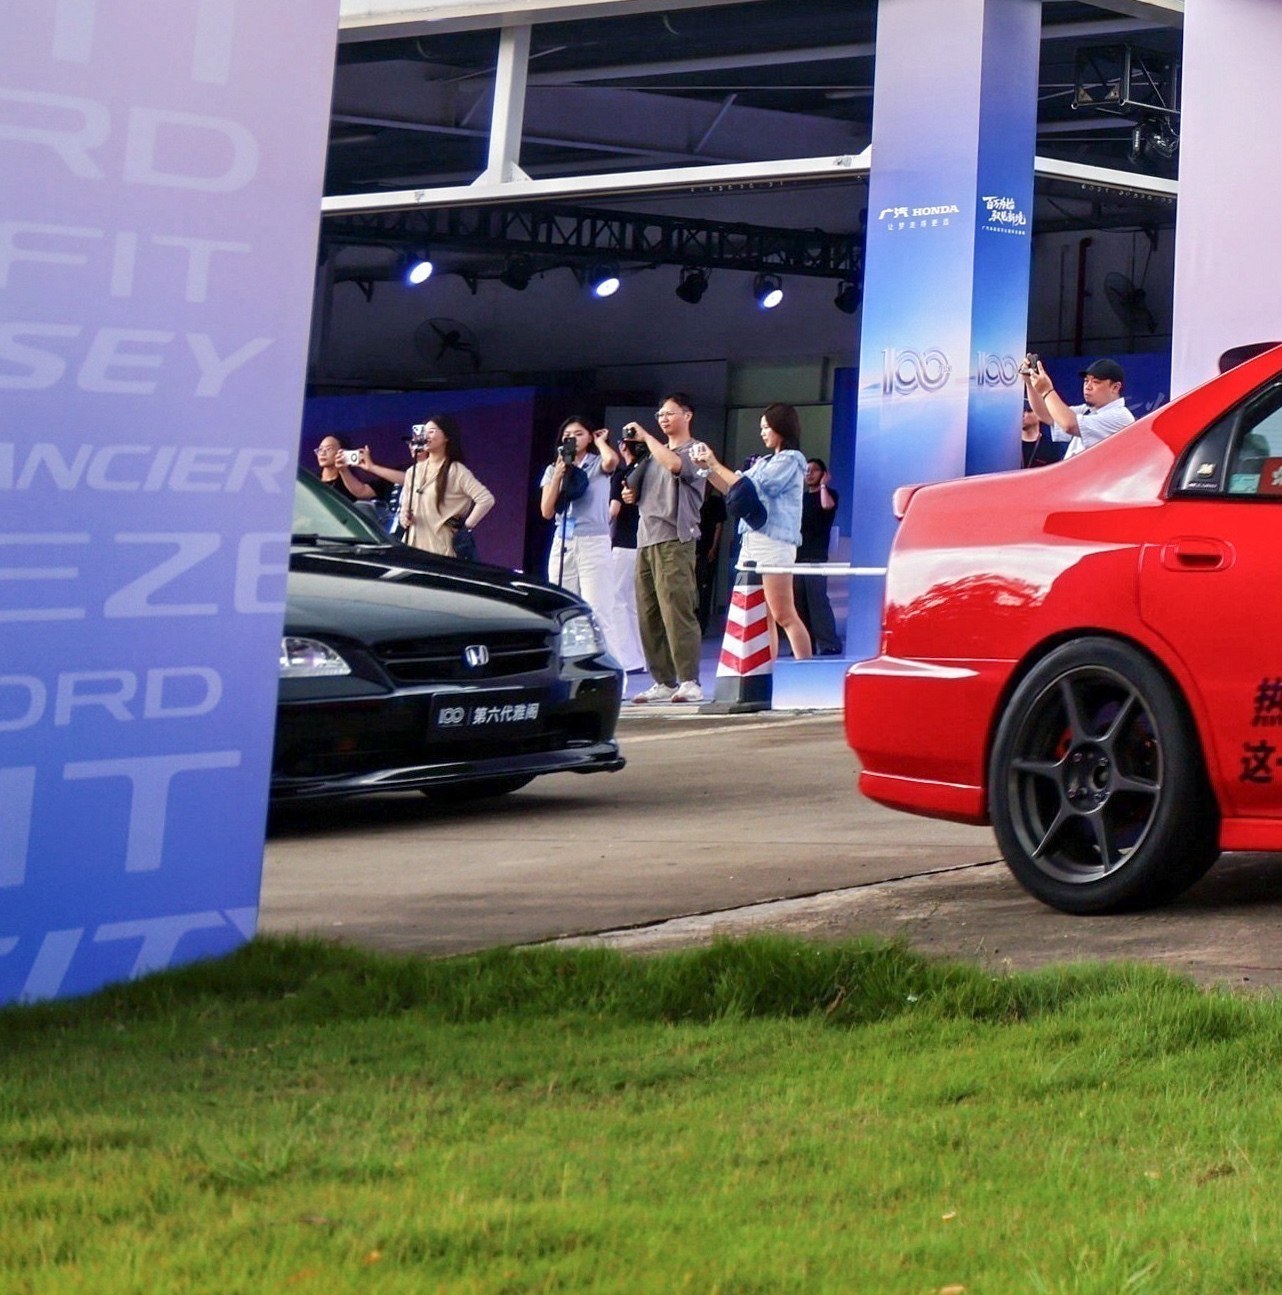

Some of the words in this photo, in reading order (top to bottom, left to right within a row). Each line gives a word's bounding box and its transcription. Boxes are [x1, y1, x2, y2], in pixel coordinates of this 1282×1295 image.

[912, 205, 960, 217] HONDA
[472, 703, 540, 725] 第六代雅阁
